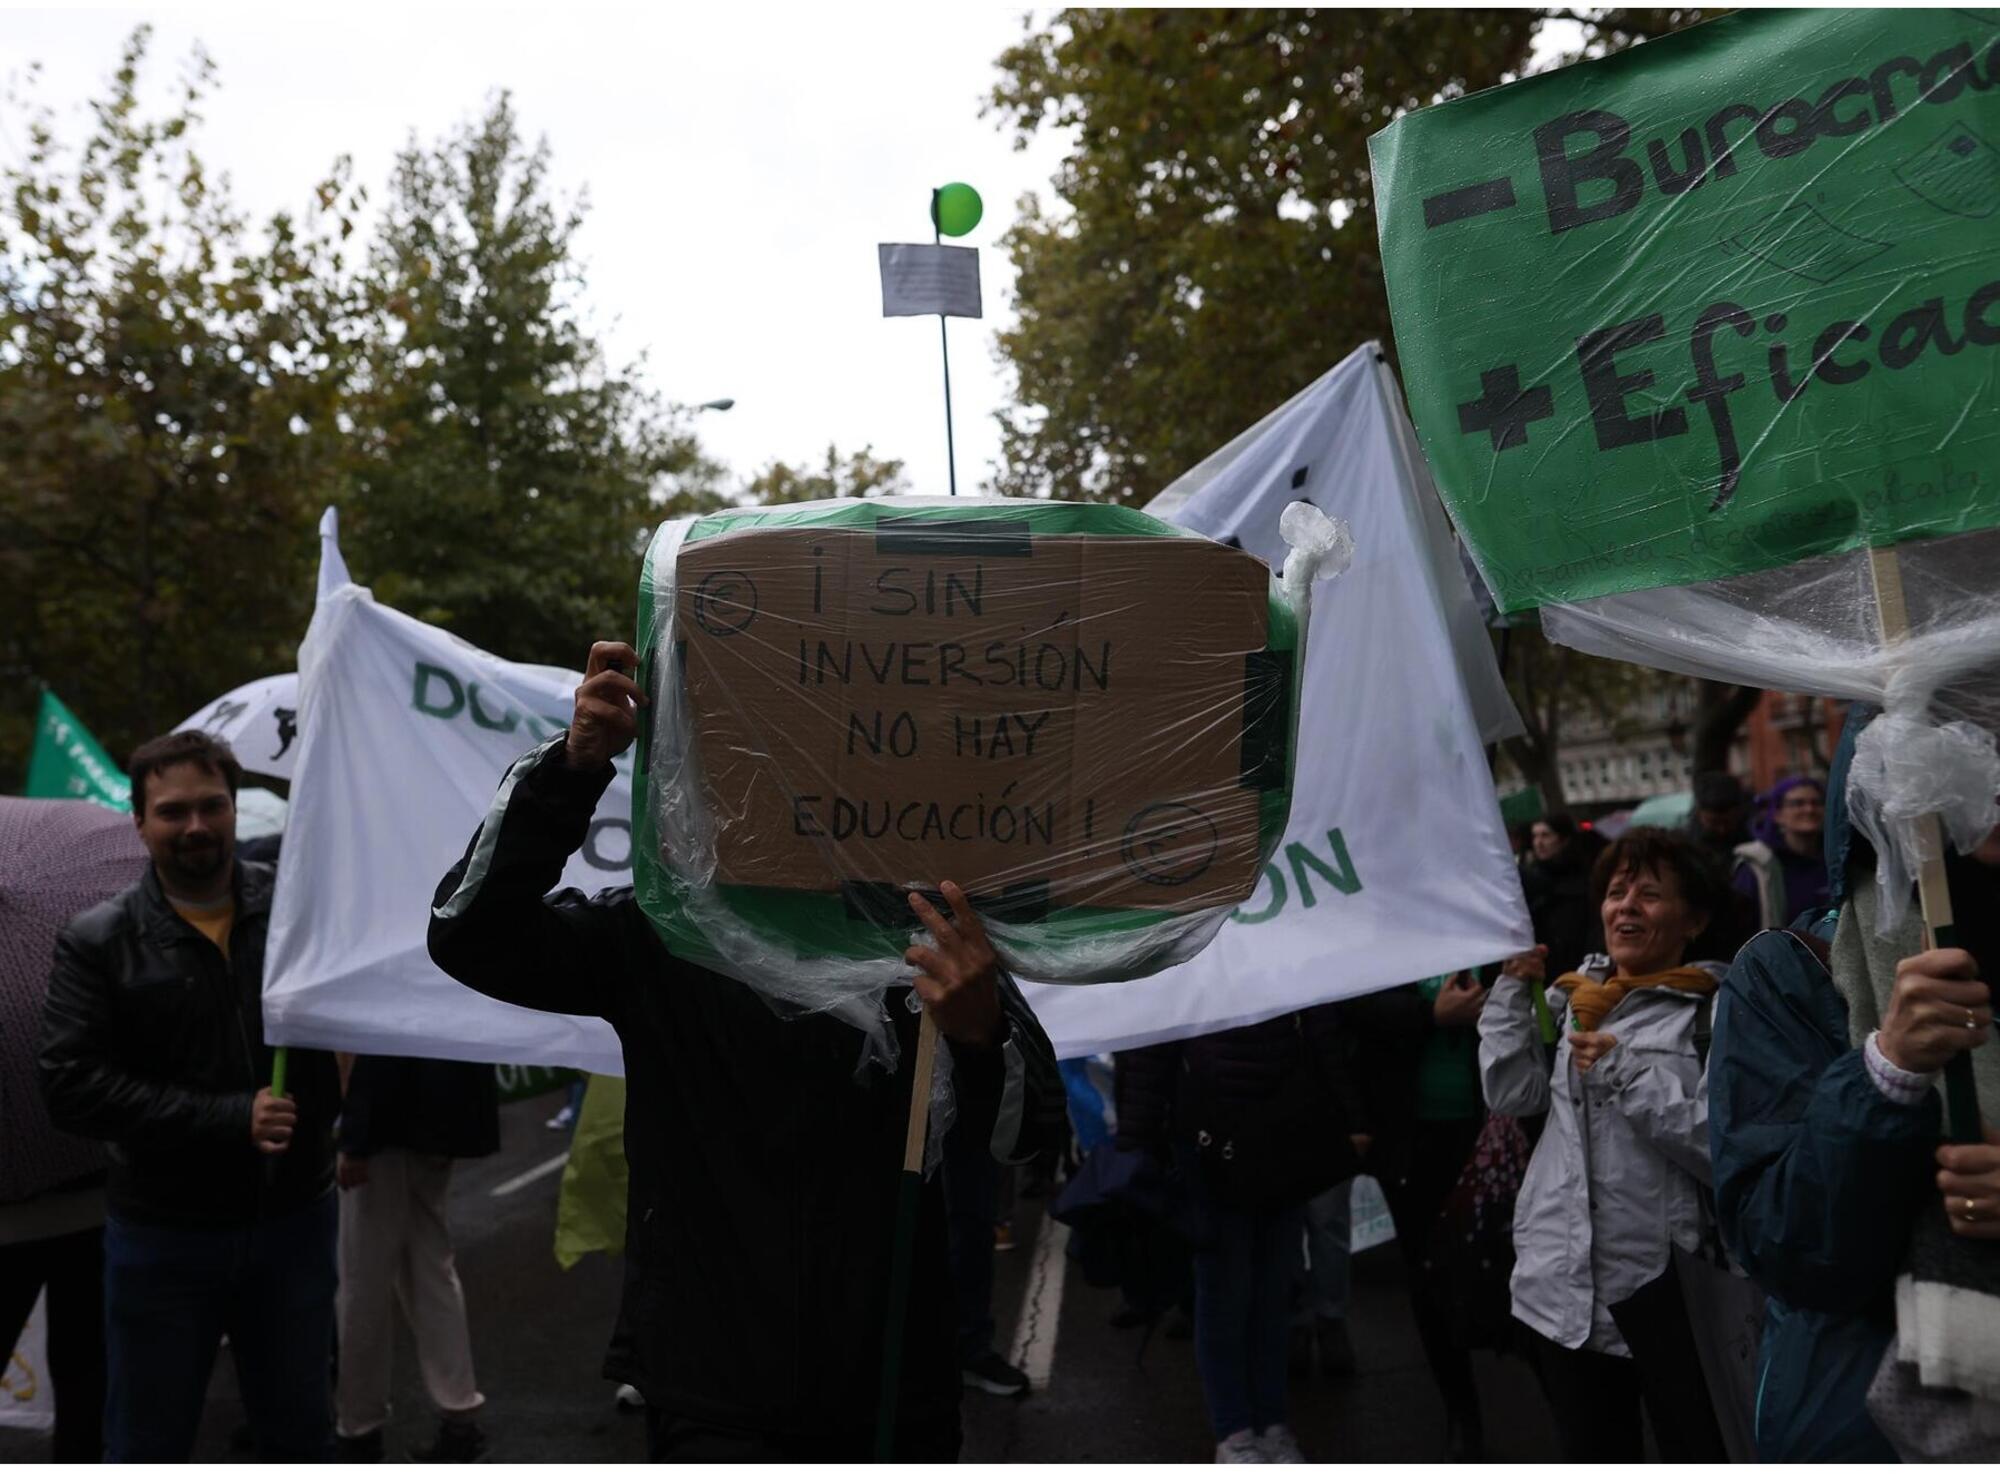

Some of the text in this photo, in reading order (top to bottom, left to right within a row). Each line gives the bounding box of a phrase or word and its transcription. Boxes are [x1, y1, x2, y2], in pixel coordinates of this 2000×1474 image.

[870, 563, 983, 617] SIN
[799, 611, 1111, 691] INVERSIÓN
[846, 710, 1051, 759] NO HAY
[793, 781, 1054, 845] EDUCACIÓN
